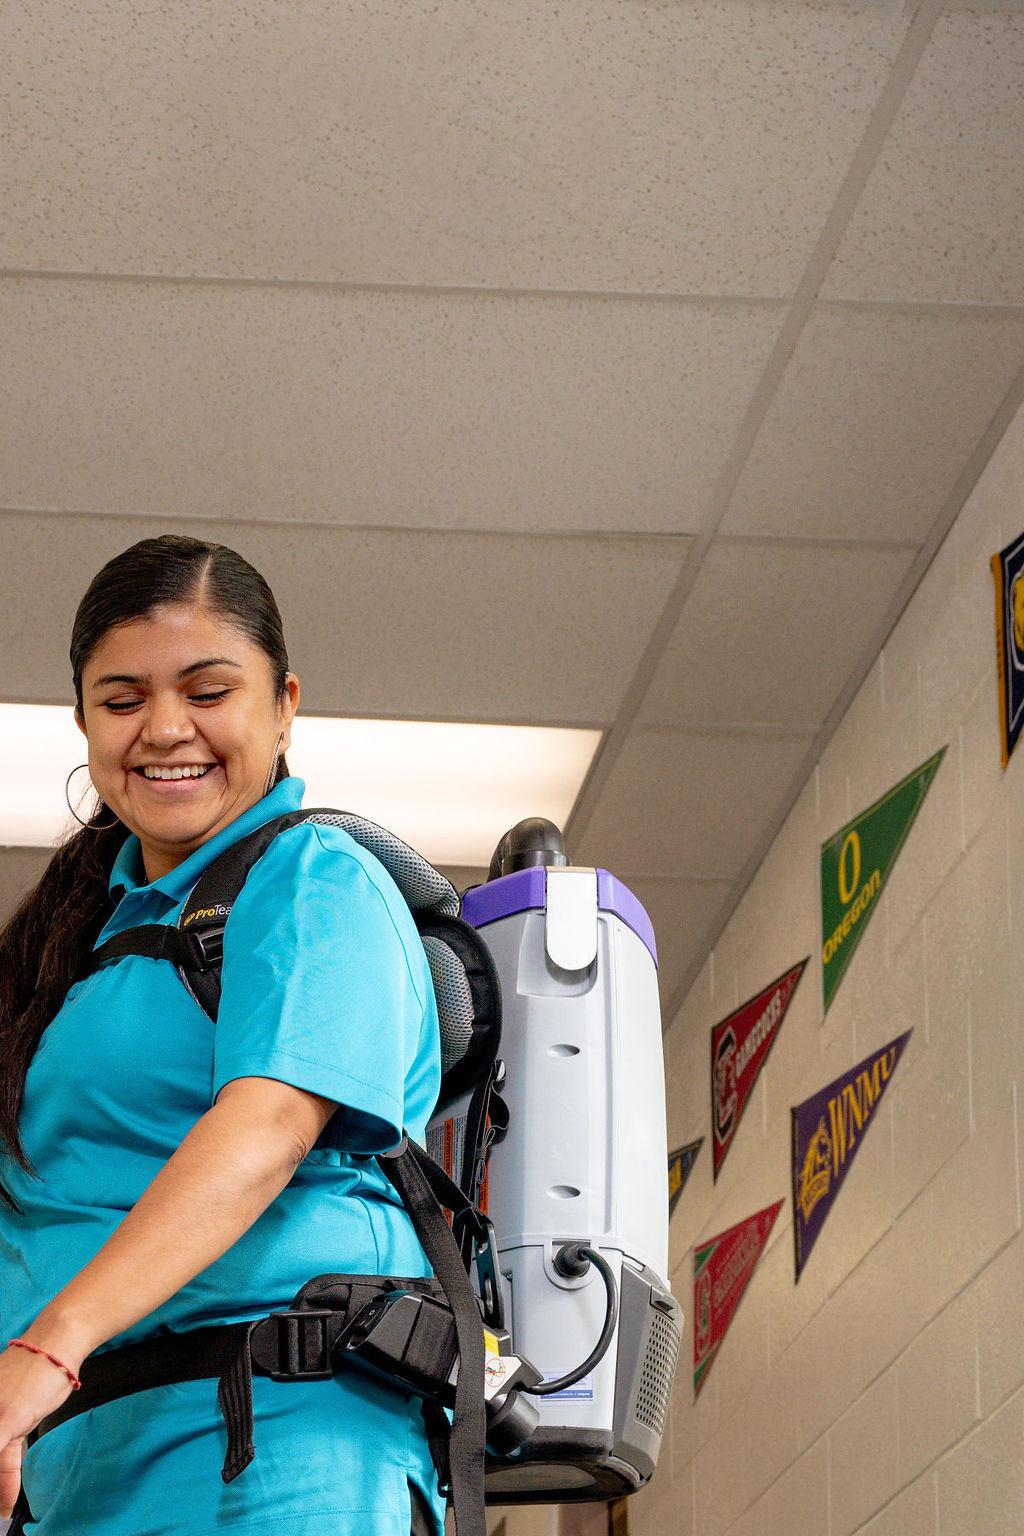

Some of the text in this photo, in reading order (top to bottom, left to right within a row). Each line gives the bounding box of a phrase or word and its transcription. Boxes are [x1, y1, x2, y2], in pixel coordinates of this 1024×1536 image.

[838, 831, 861, 904] O
[194, 905, 232, 920] ProTea
[827, 1045, 896, 1177] WNMU
